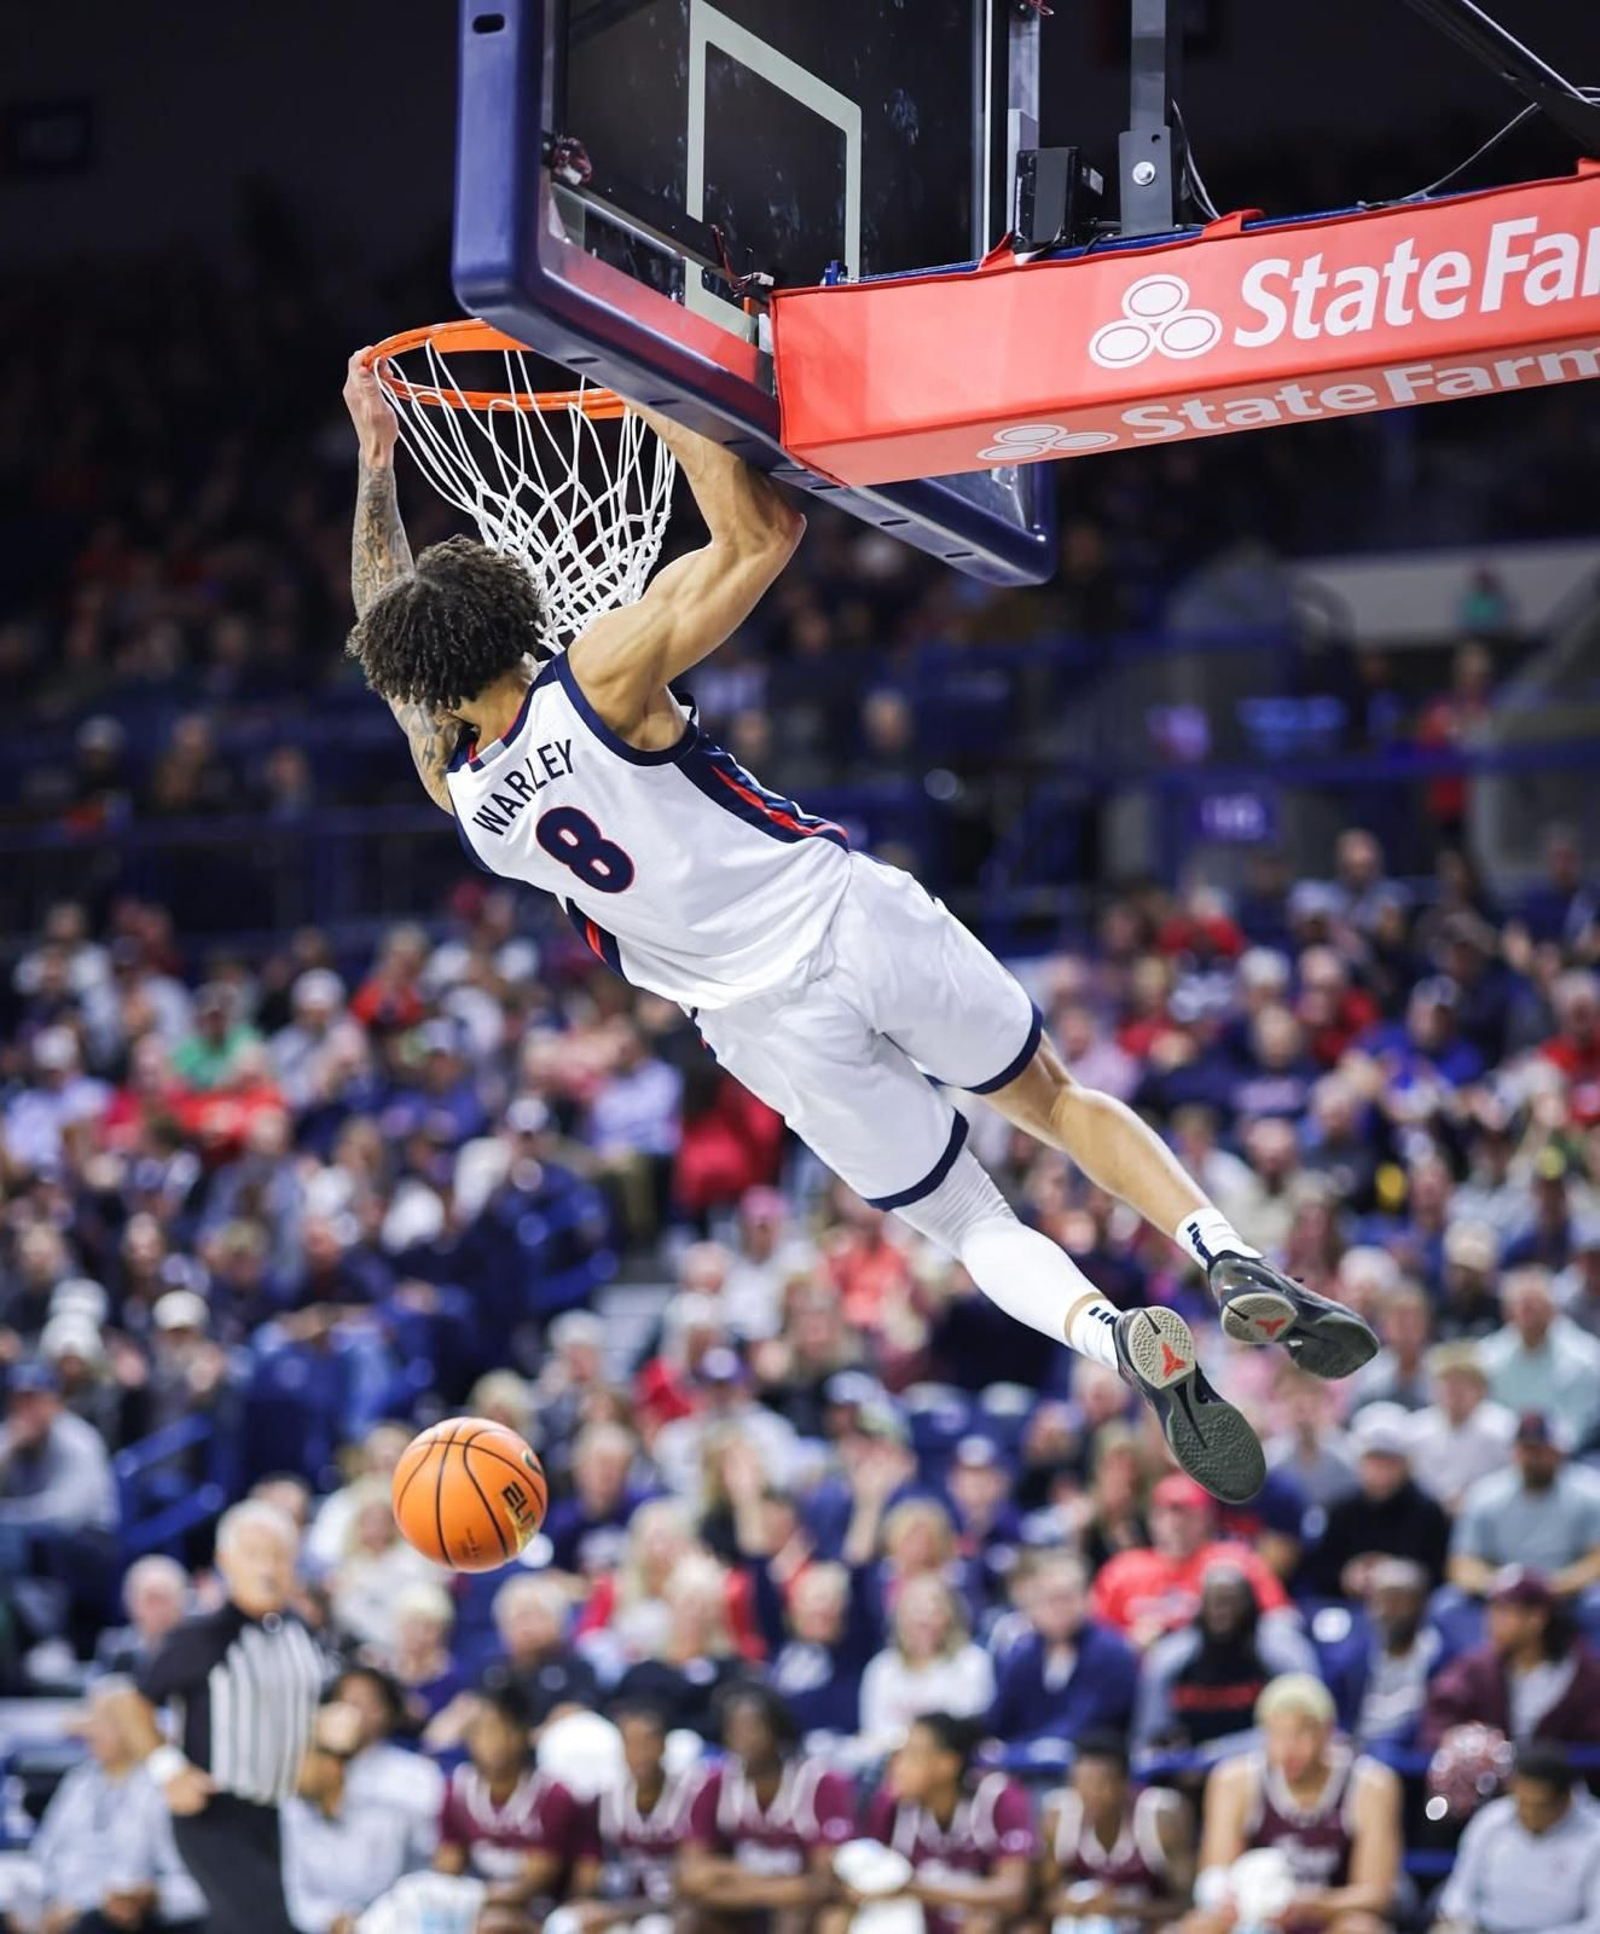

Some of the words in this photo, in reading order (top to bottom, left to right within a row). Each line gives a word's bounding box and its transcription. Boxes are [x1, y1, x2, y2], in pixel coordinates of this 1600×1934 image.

[1120, 382, 1379, 440] State
[472, 738, 575, 836] WARLEY
[535, 806, 636, 893] 8
